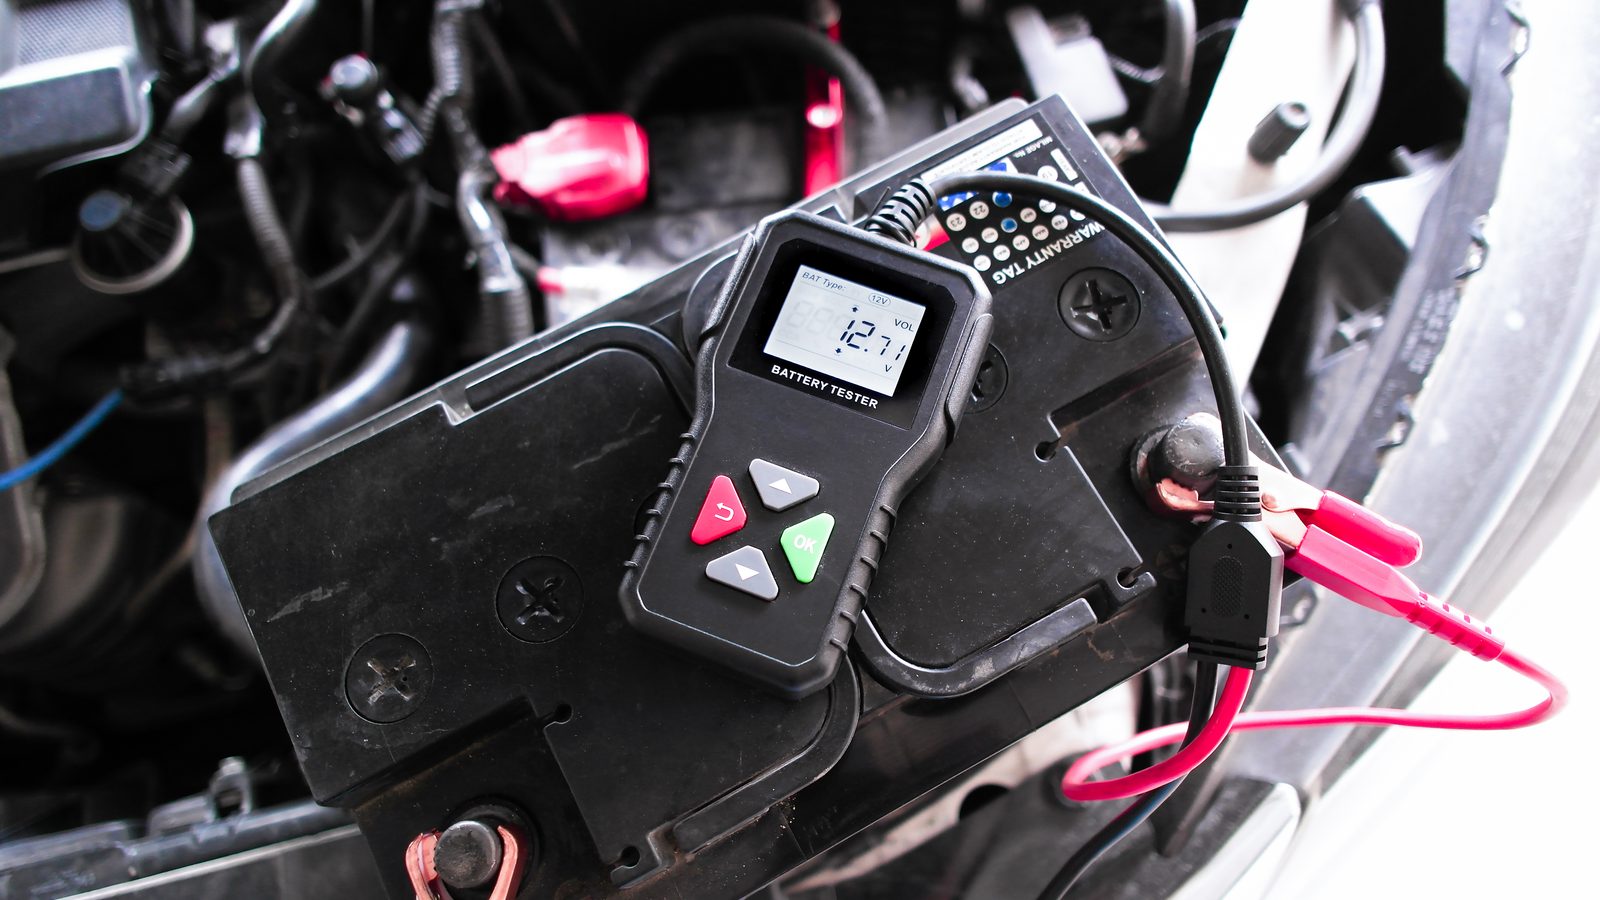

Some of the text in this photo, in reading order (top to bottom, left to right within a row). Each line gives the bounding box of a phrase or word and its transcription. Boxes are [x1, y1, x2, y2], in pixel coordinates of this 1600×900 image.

[950, 204, 986, 228] 22 23
[992, 221, 1105, 284] WARRANTY TAG
[802, 271, 846, 292] BAT Type:
[871, 294, 889, 305] 12V
[894, 318, 914, 332] VOL
[840, 319, 906, 361] 12.71
[885, 364, 893, 373] V
[771, 364, 879, 409] BATTERY TESTER
[793, 534, 817, 554] OK
